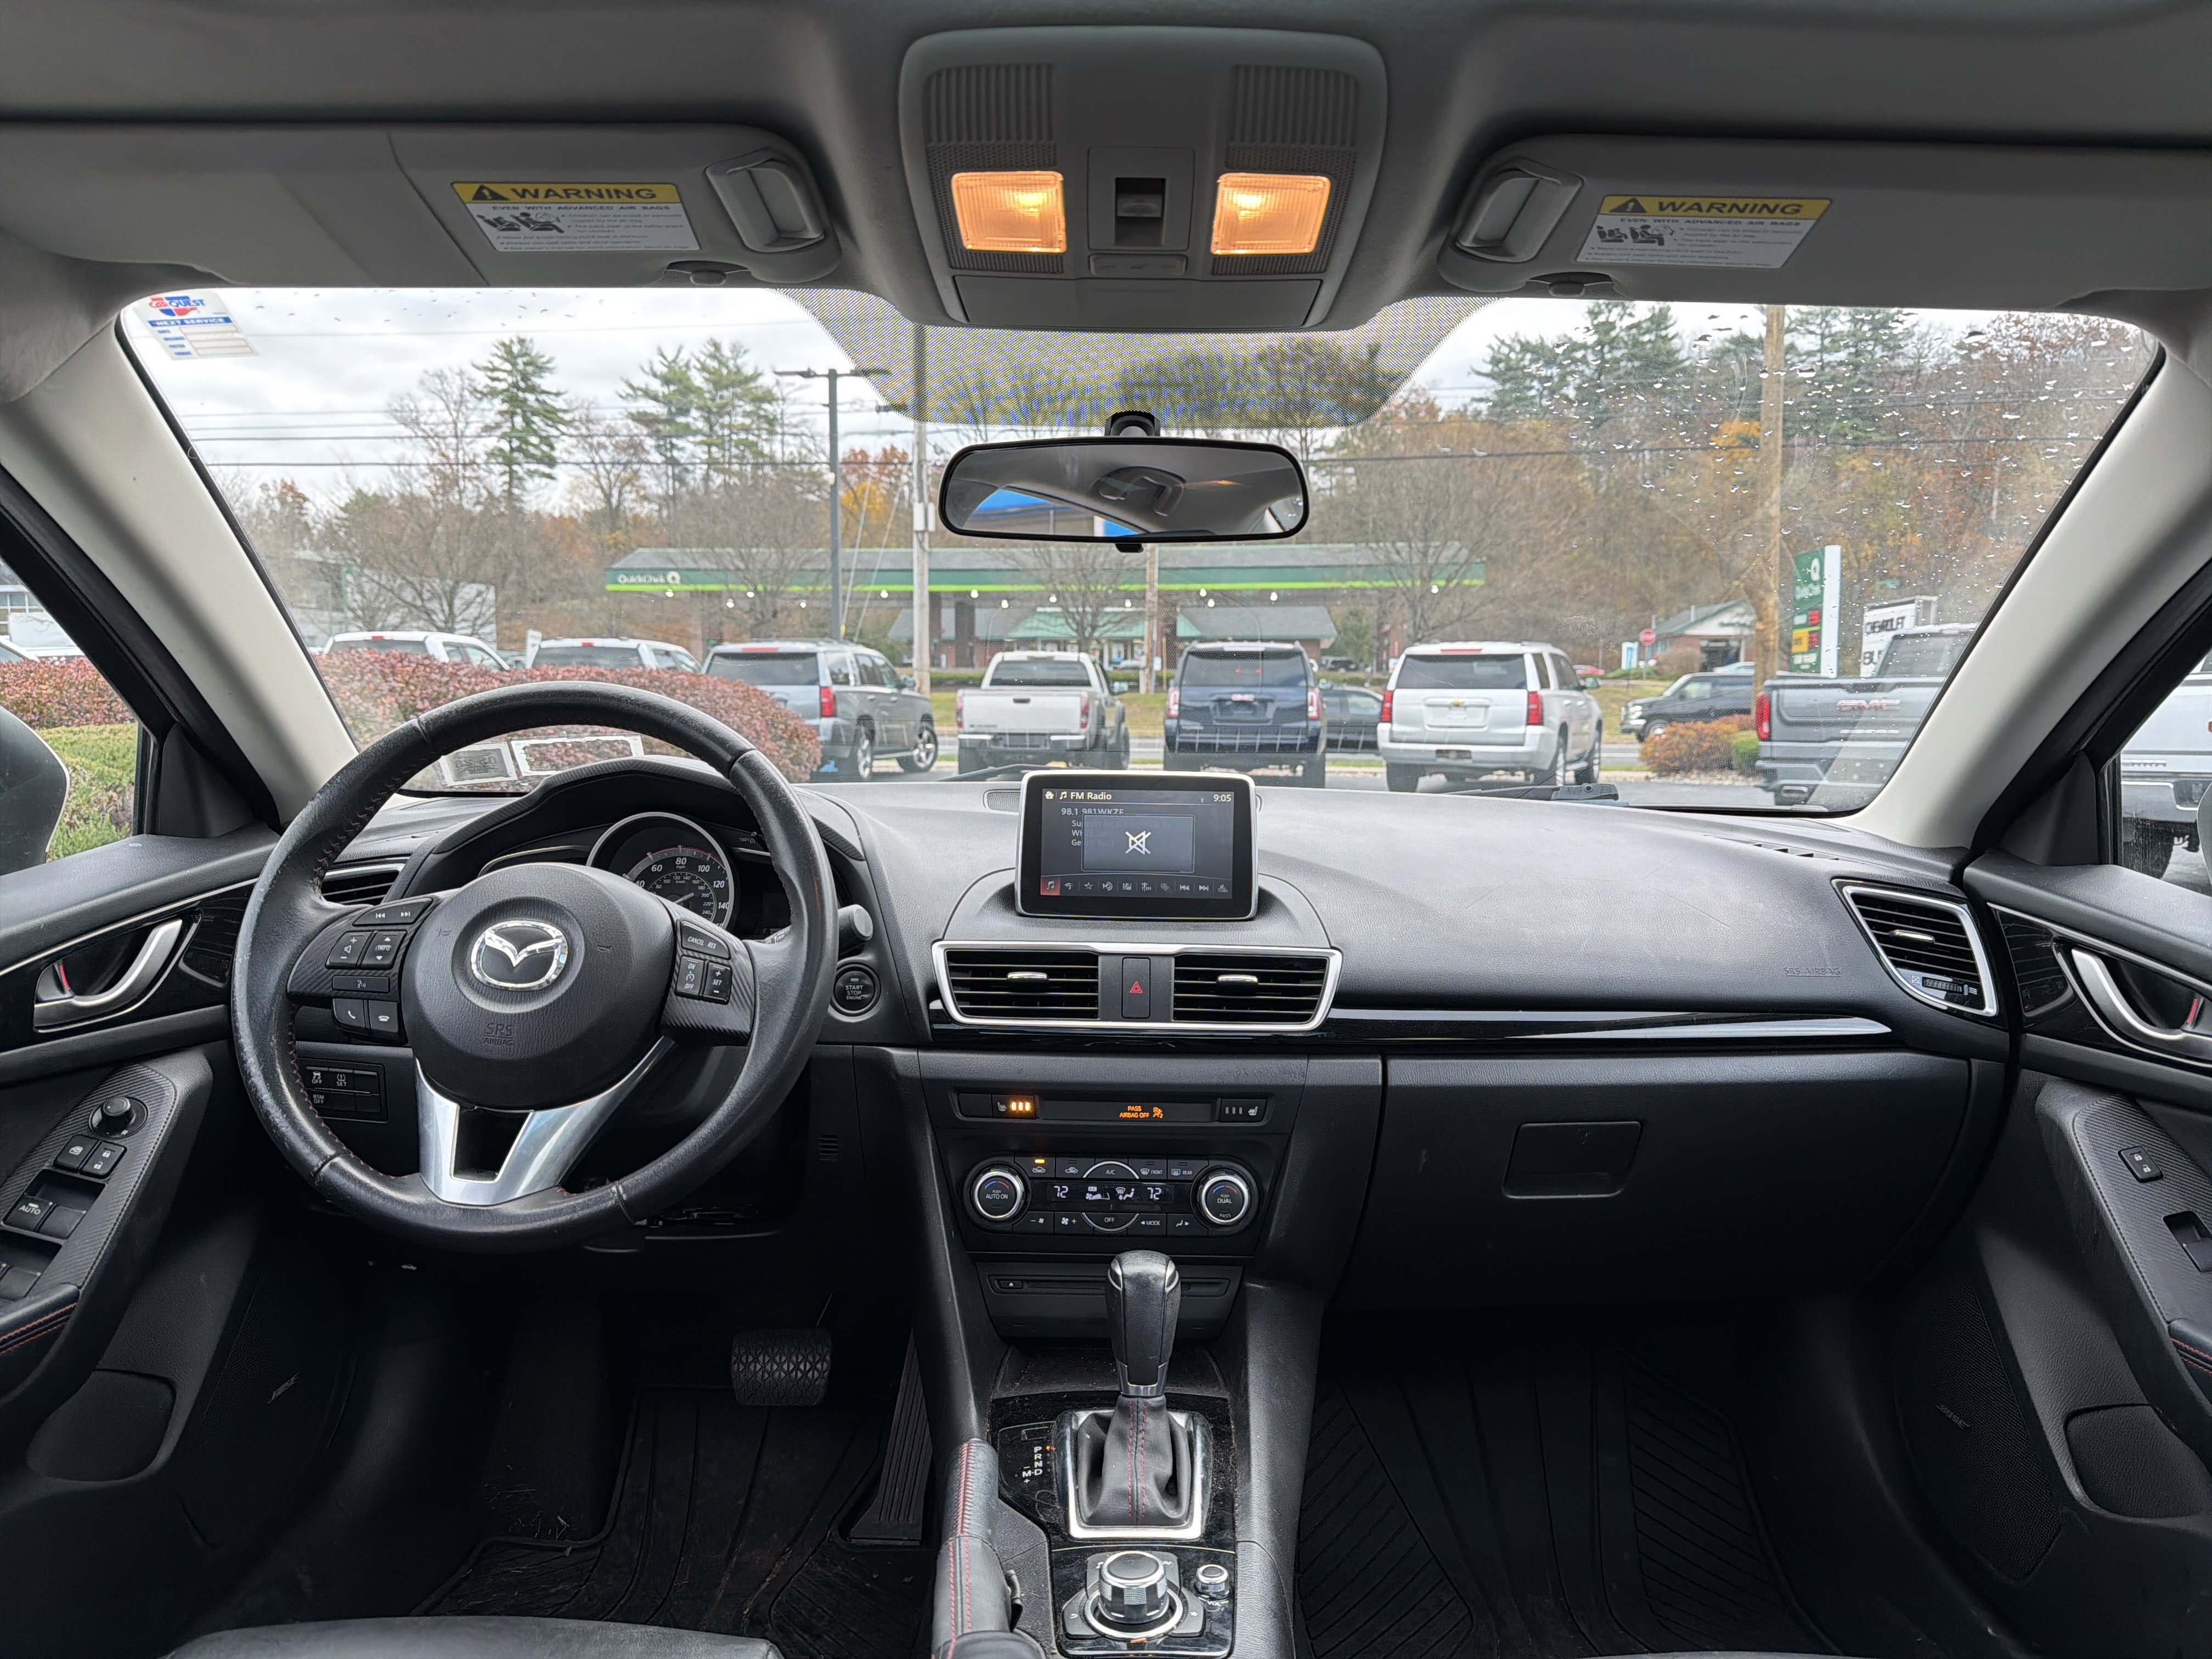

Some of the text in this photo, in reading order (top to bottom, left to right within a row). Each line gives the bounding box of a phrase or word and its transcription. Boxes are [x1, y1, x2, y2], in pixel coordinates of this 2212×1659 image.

[511, 188, 656, 199] WARNING
[1658, 201, 1803, 215] WARNING
[1087, 792, 1111, 800] Radio
[1214, 794, 1231, 803] 9:05
[687, 936, 704, 946] CANCEL
[486, 1023, 514, 1036] SRS
[484, 1037, 514, 1046] AIRBAG
[1054, 1186, 1068, 1198] 72
[1147, 1187, 1162, 1200] 72
[19, 1205, 41, 1215] AUTO
